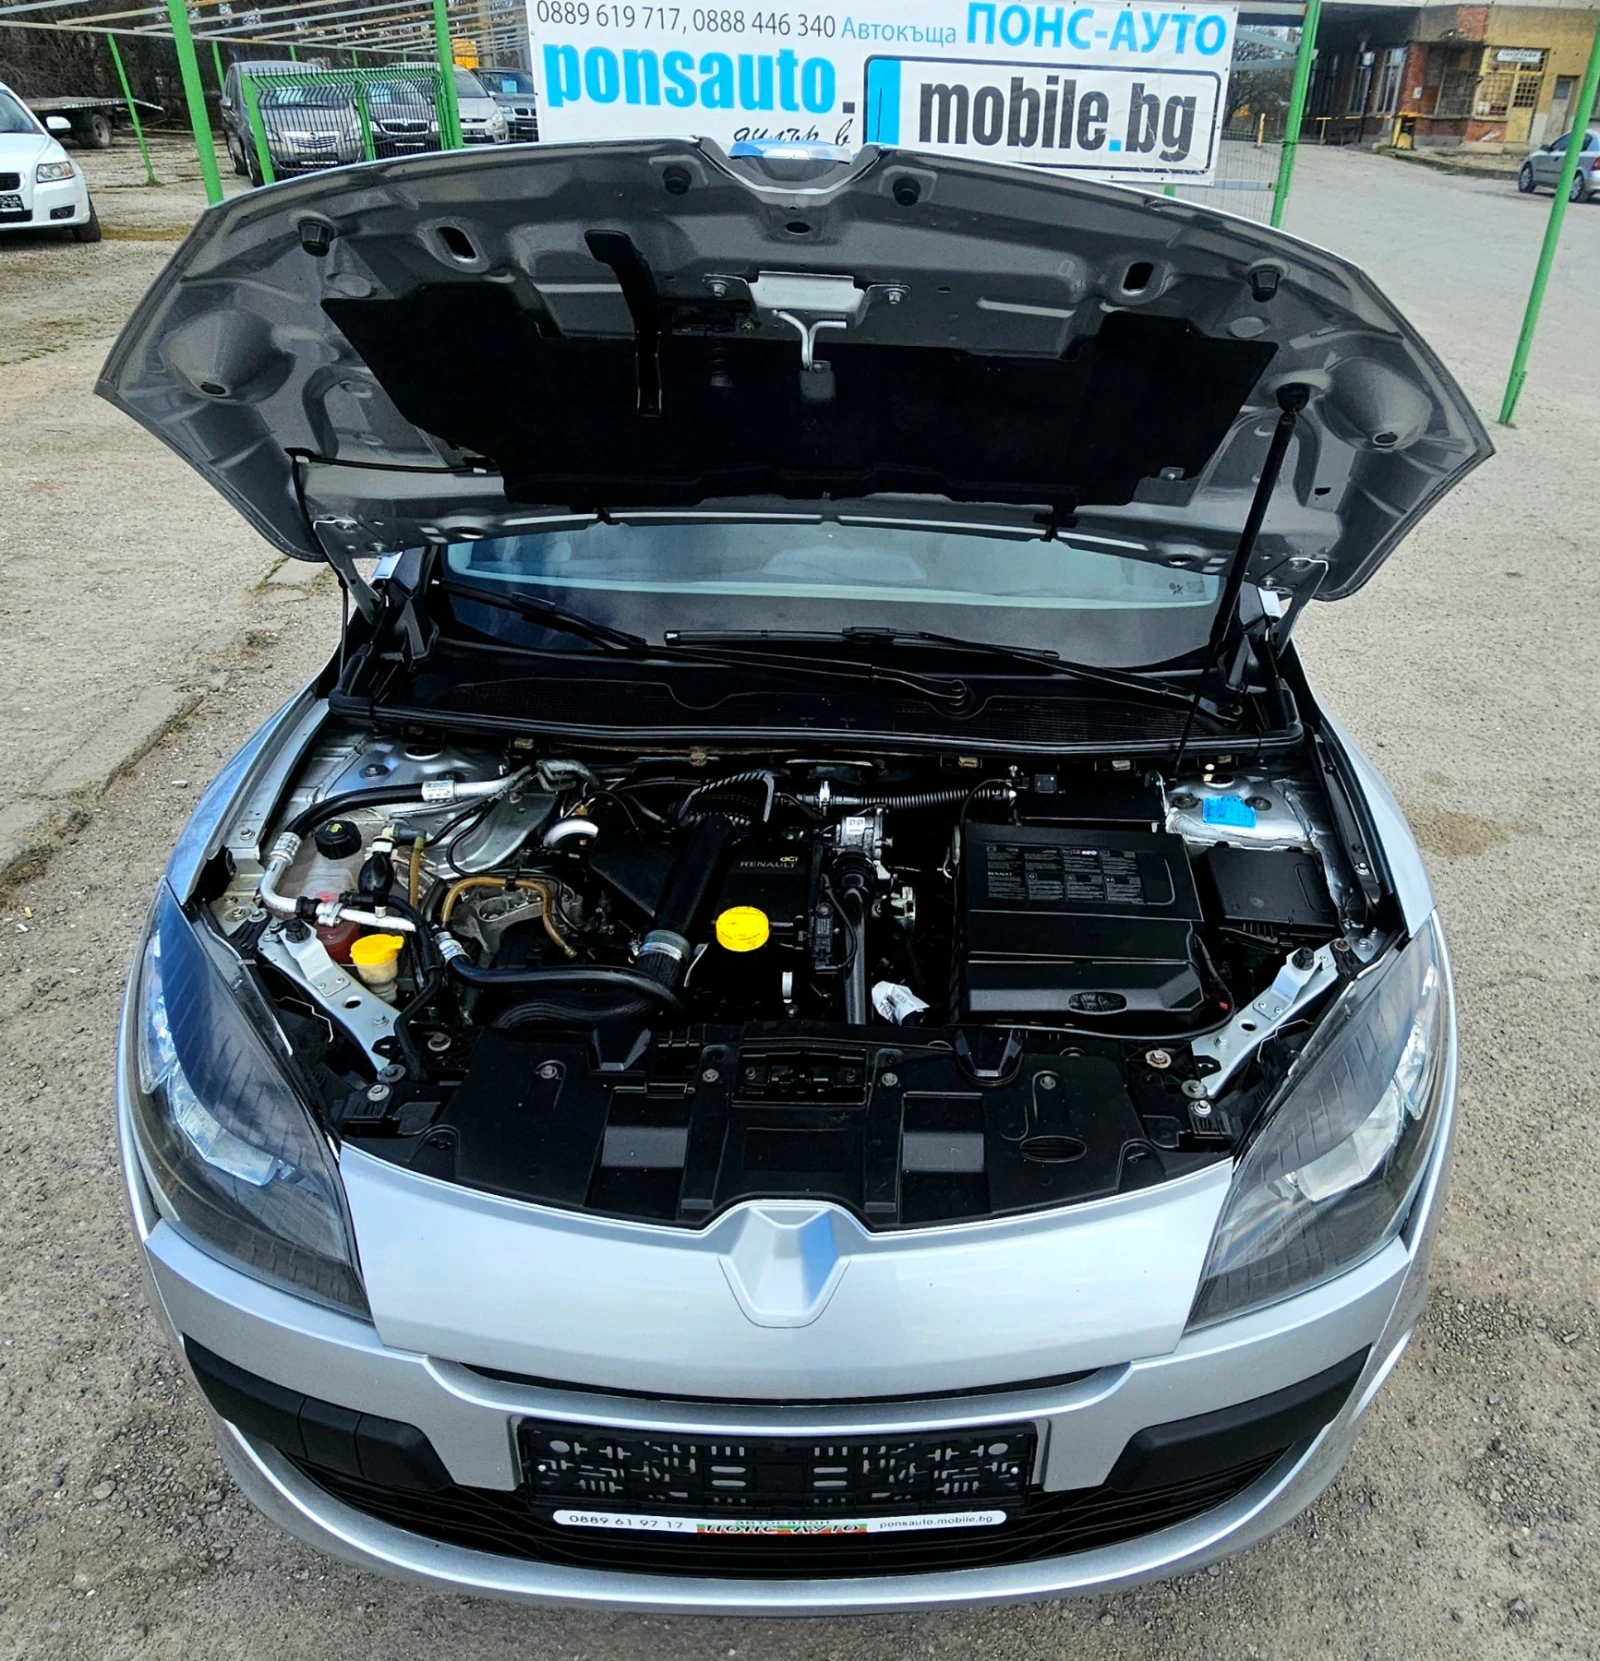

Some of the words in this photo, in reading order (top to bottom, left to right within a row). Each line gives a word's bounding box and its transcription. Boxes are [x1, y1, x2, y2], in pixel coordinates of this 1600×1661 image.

[537, 0, 590, 25] 0889
[596, 4, 636, 28] 619
[642, 7, 687, 34] 717,
[693, 9, 745, 33] 0888
[752, 11, 791, 36] 446
[797, 14, 836, 38] 340
[841, 16, 956, 48] Автокъща
[967, 2, 1227, 56] ПОНС-АУТО
[919, 75, 1198, 163] mobile.bg
[569, 1514, 608, 1525] 0889
[615, 1518, 632, 1526] 61
[639, 1519, 658, 1527] 97
[666, 1521, 683, 1529] 17
[880, 1515, 993, 1529] ponsauto.mobile.bg
